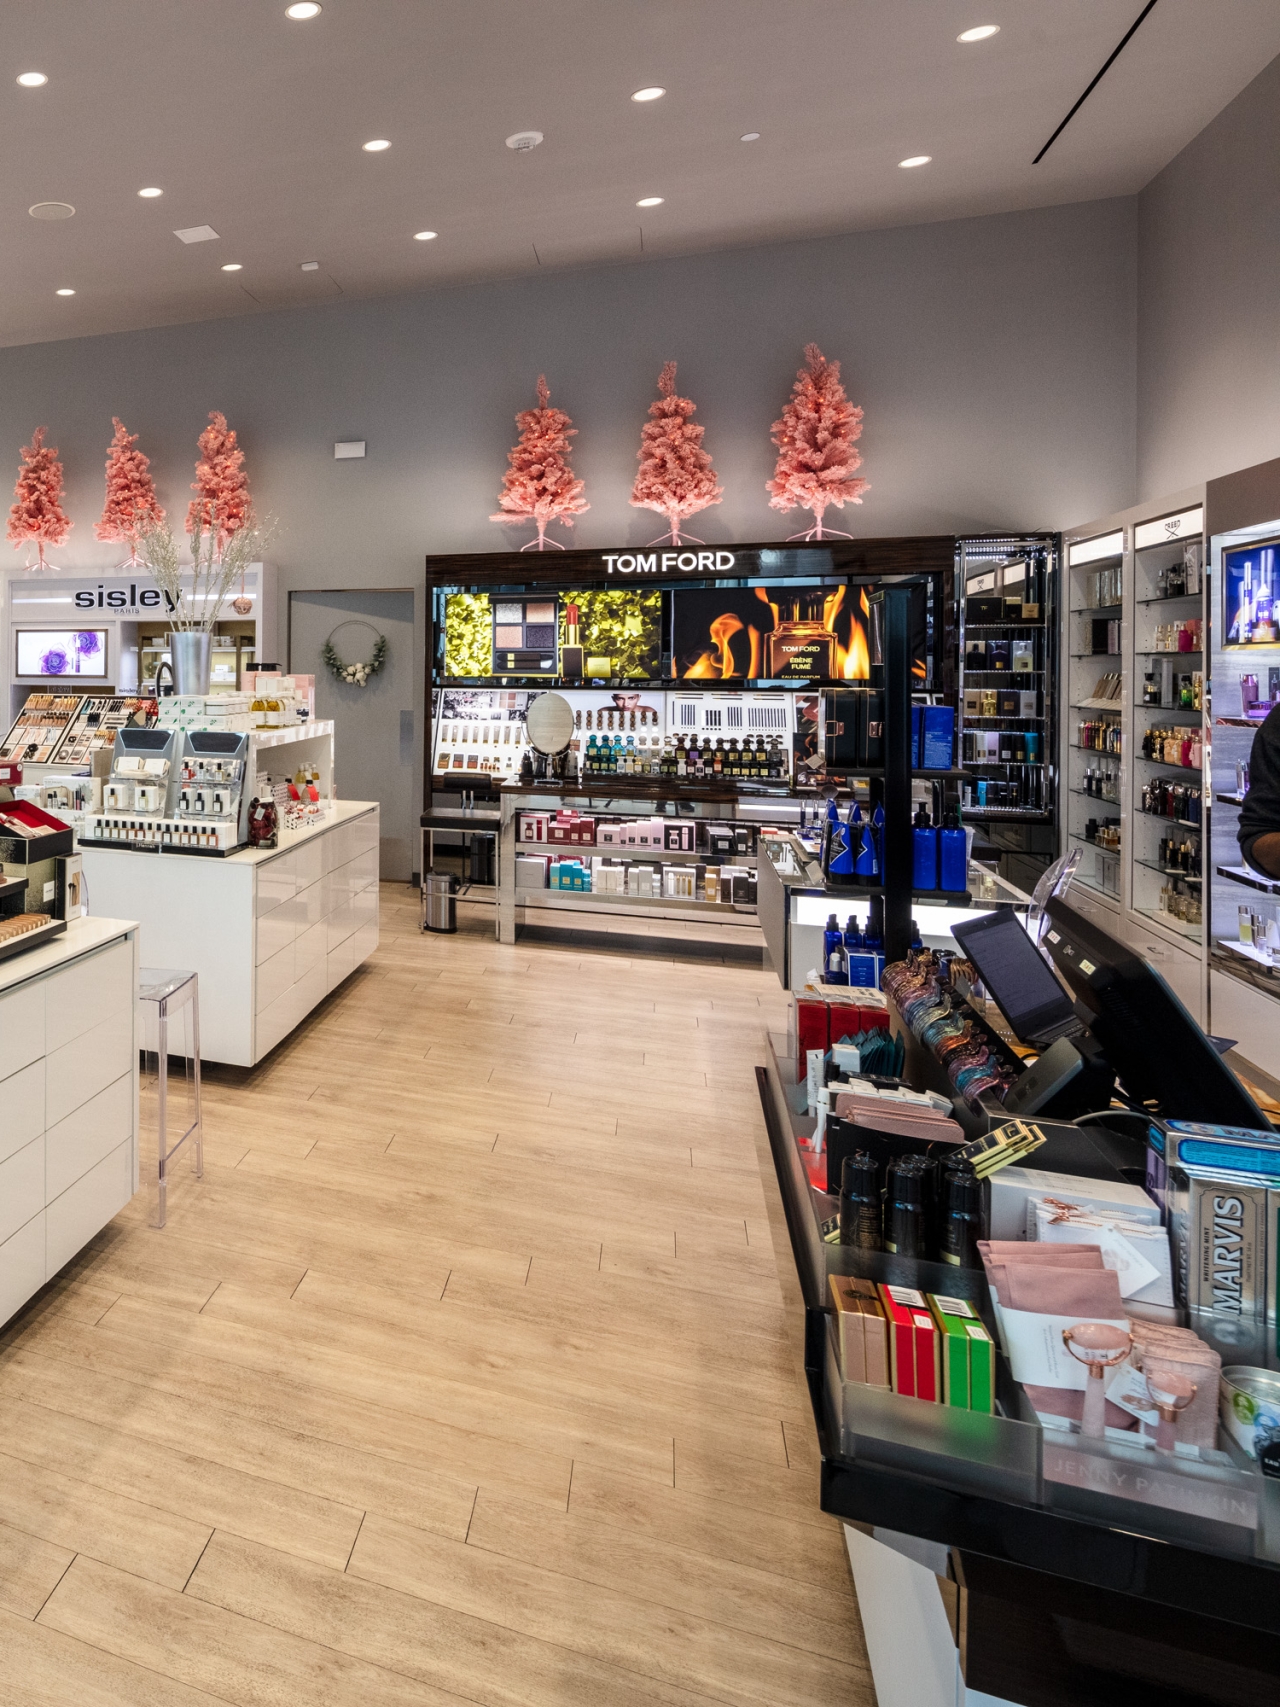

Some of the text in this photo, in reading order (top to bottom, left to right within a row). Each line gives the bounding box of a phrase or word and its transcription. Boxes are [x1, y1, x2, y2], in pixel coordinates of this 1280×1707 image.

[602, 551, 735, 573] TOM FORD
[75, 584, 183, 613] sisley
[789, 656, 813, 664] ÉBÈNE
[1202, 1227, 1210, 1282] WHITENING MINT
[1212, 1195, 1244, 1315] MARVIS
[1054, 1459, 1127, 1487] JENNY
